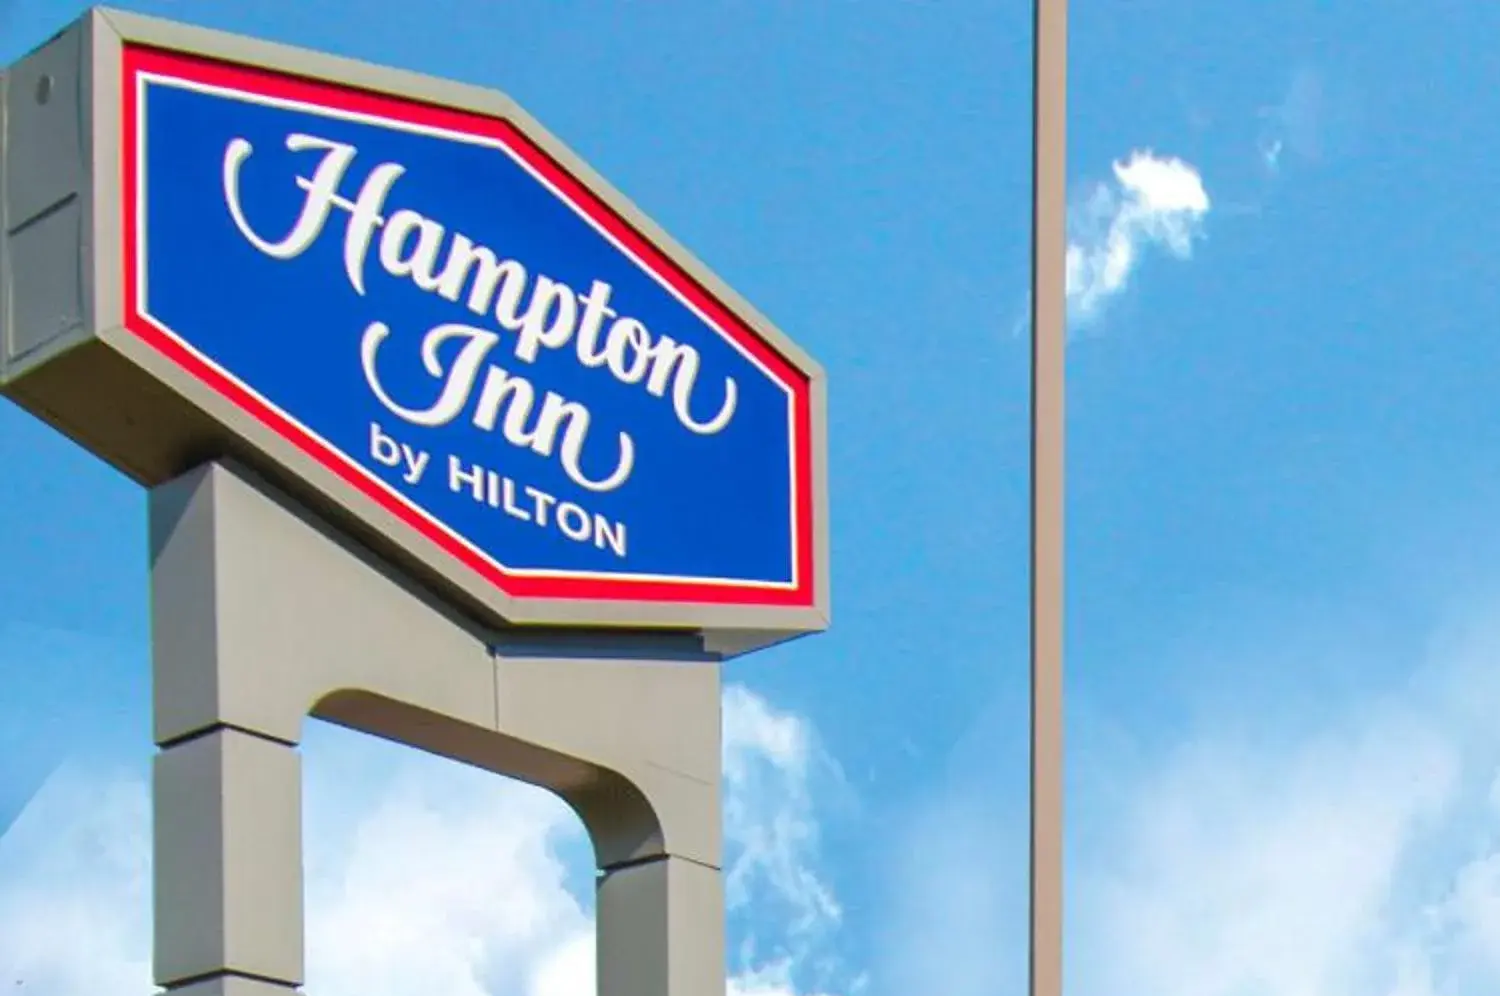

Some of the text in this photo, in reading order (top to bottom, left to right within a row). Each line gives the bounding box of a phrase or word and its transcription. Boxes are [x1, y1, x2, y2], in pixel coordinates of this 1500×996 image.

[222, 132, 738, 434] Hampton
[360, 320, 636, 493] Inn
[369, 422, 628, 559] by HILTON
